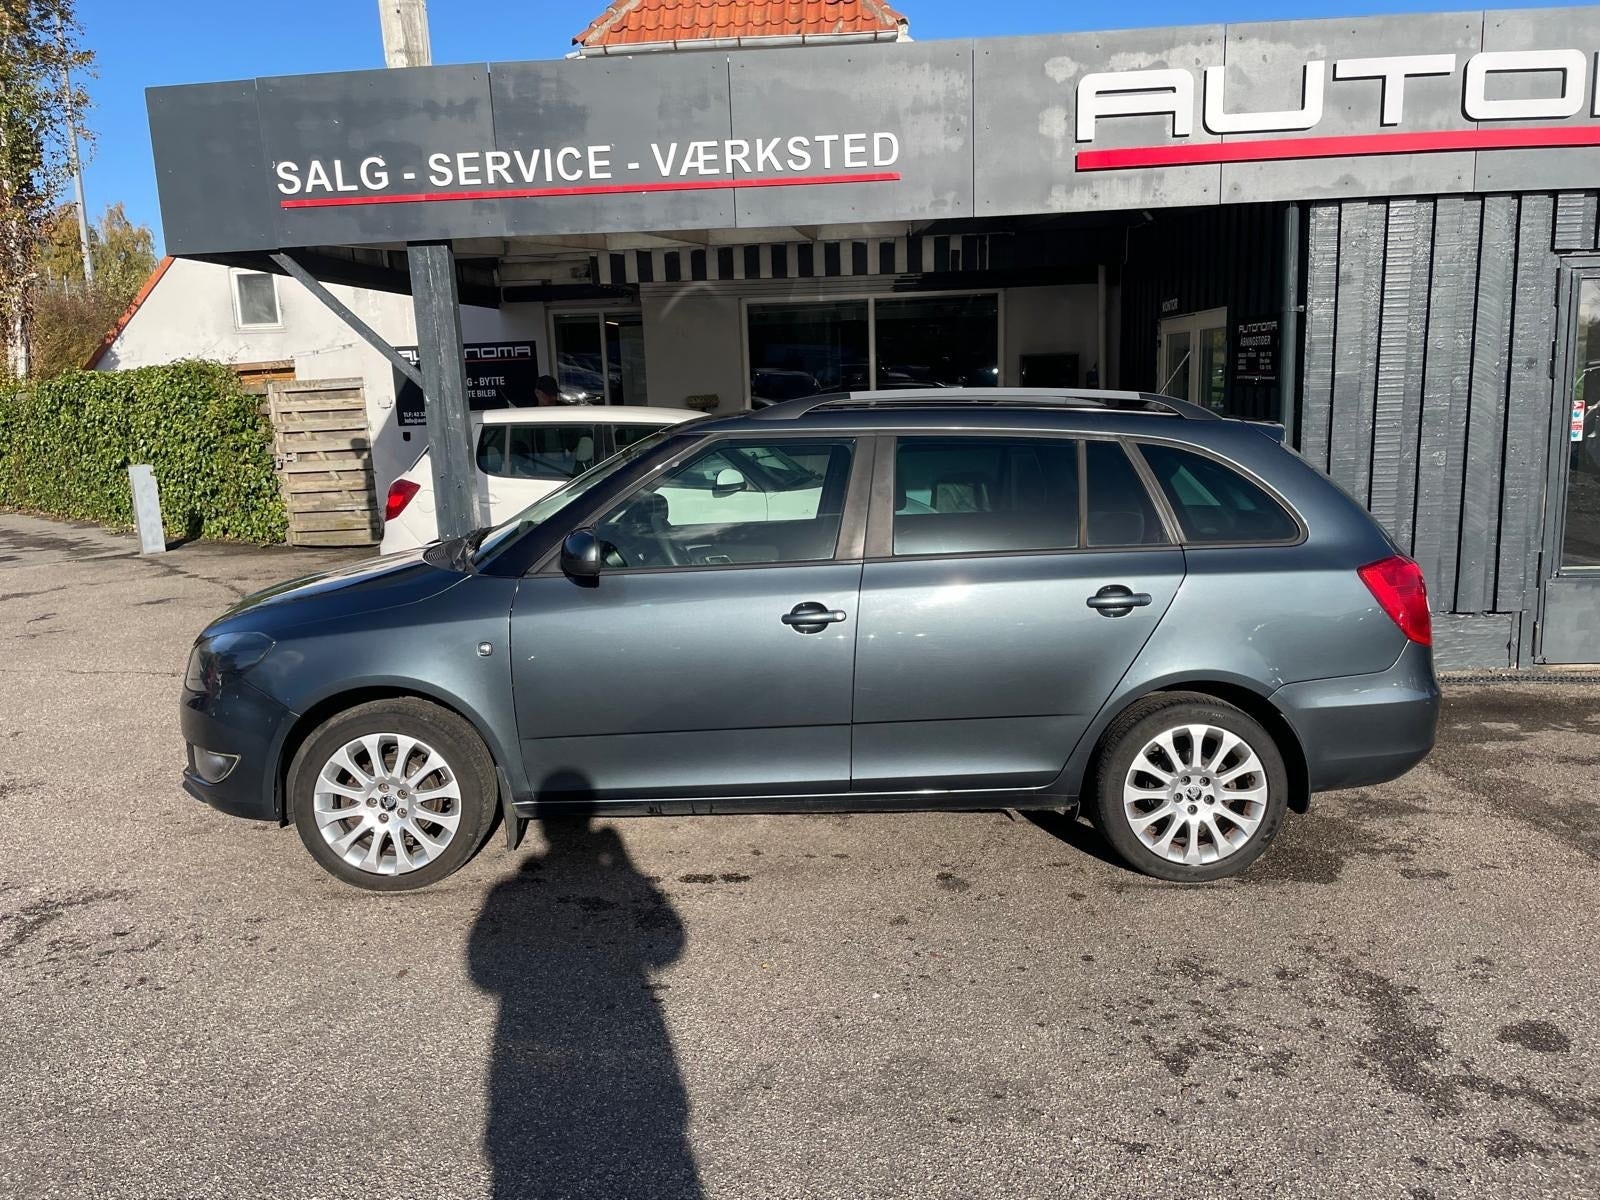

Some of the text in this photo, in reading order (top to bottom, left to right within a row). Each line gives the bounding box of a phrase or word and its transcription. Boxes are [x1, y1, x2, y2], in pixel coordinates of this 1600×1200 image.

[1076, 48, 1600, 143] AUTO
[276, 156, 389, 195] SALG
[428, 145, 613, 187] SERVICE
[650, 131, 900, 177] VÆRKSTED
[1239, 321, 1278, 333] AUTONOMA
[479, 376, 505, 386] BYTTE
[477, 389, 496, 398] BILER
